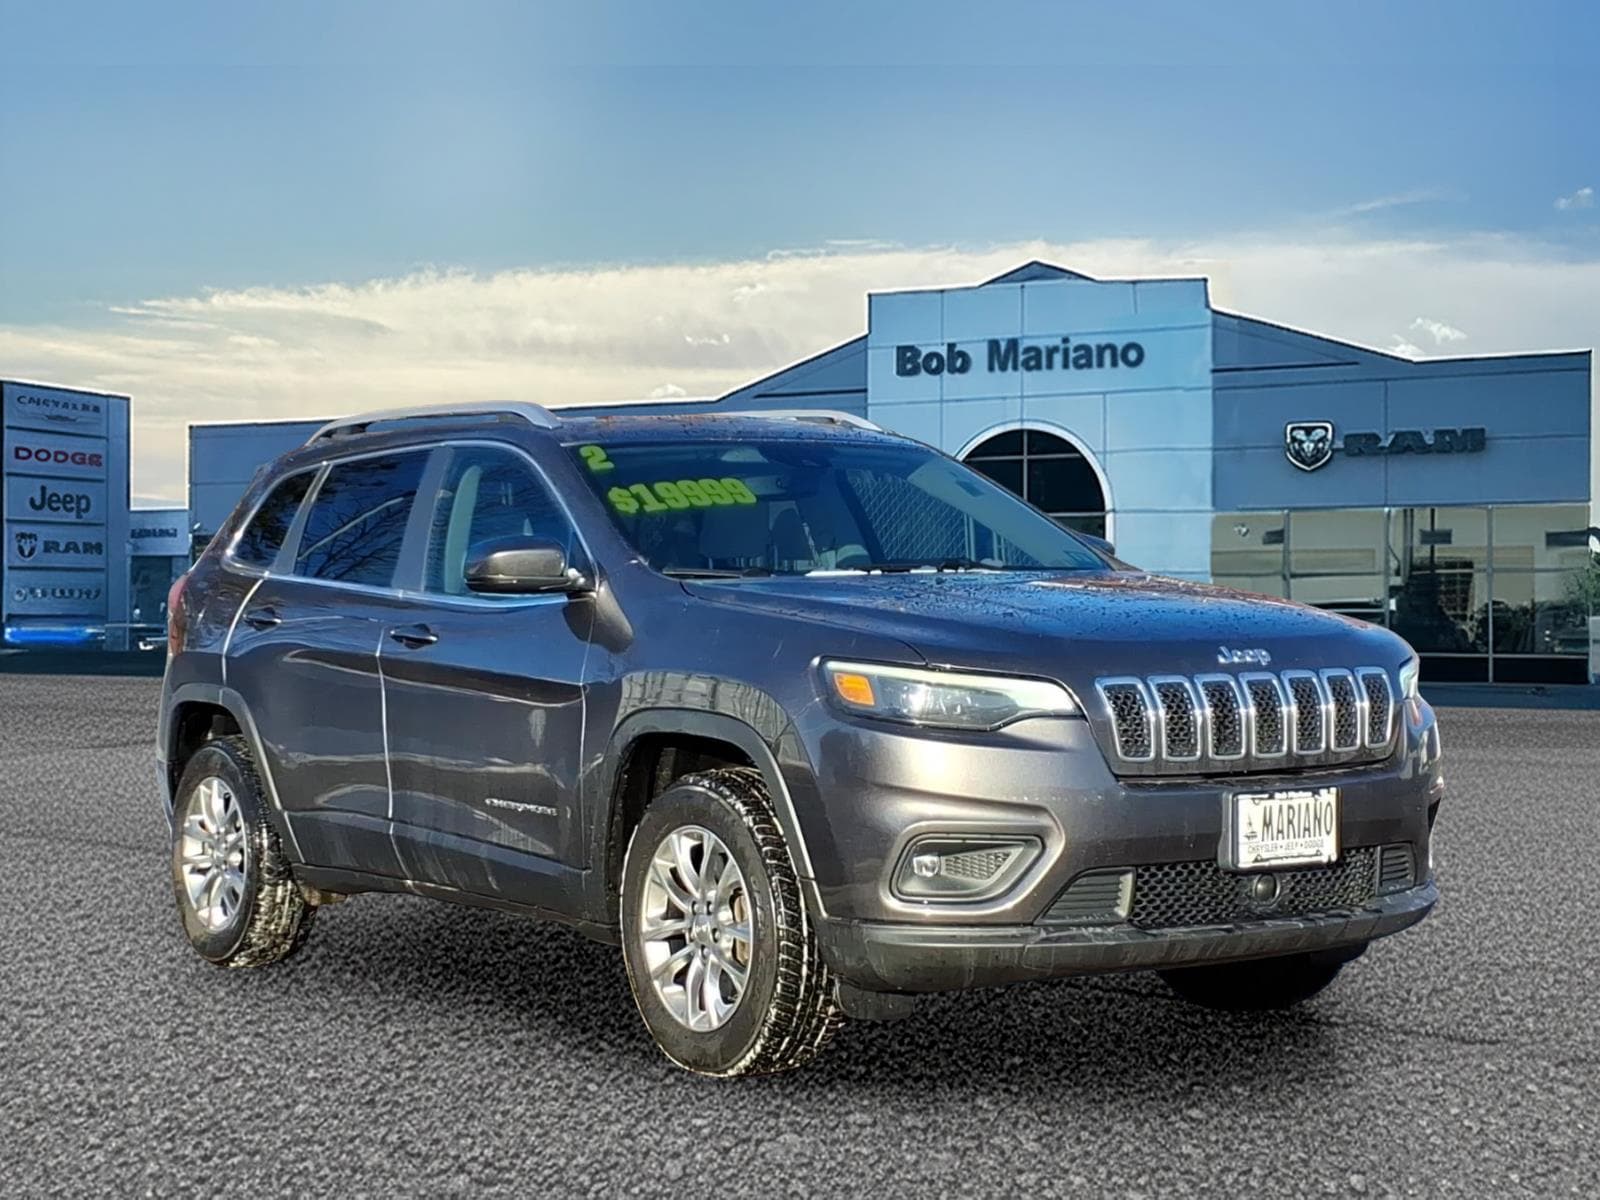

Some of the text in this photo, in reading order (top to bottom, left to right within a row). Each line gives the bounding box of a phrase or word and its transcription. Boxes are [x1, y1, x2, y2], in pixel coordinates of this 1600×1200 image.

[896, 337, 1145, 377] Bob Mariano
[14, 446, 103, 467] DODGE
[1344, 428, 1486, 457] RAM
[579, 445, 615, 471] 2
[29, 485, 91, 519] Jeep
[608, 478, 757, 514] $19999
[43, 540, 103, 555] RAM
[1217, 645, 1271, 666] Jeep
[1262, 801, 1333, 842] MARIANO
